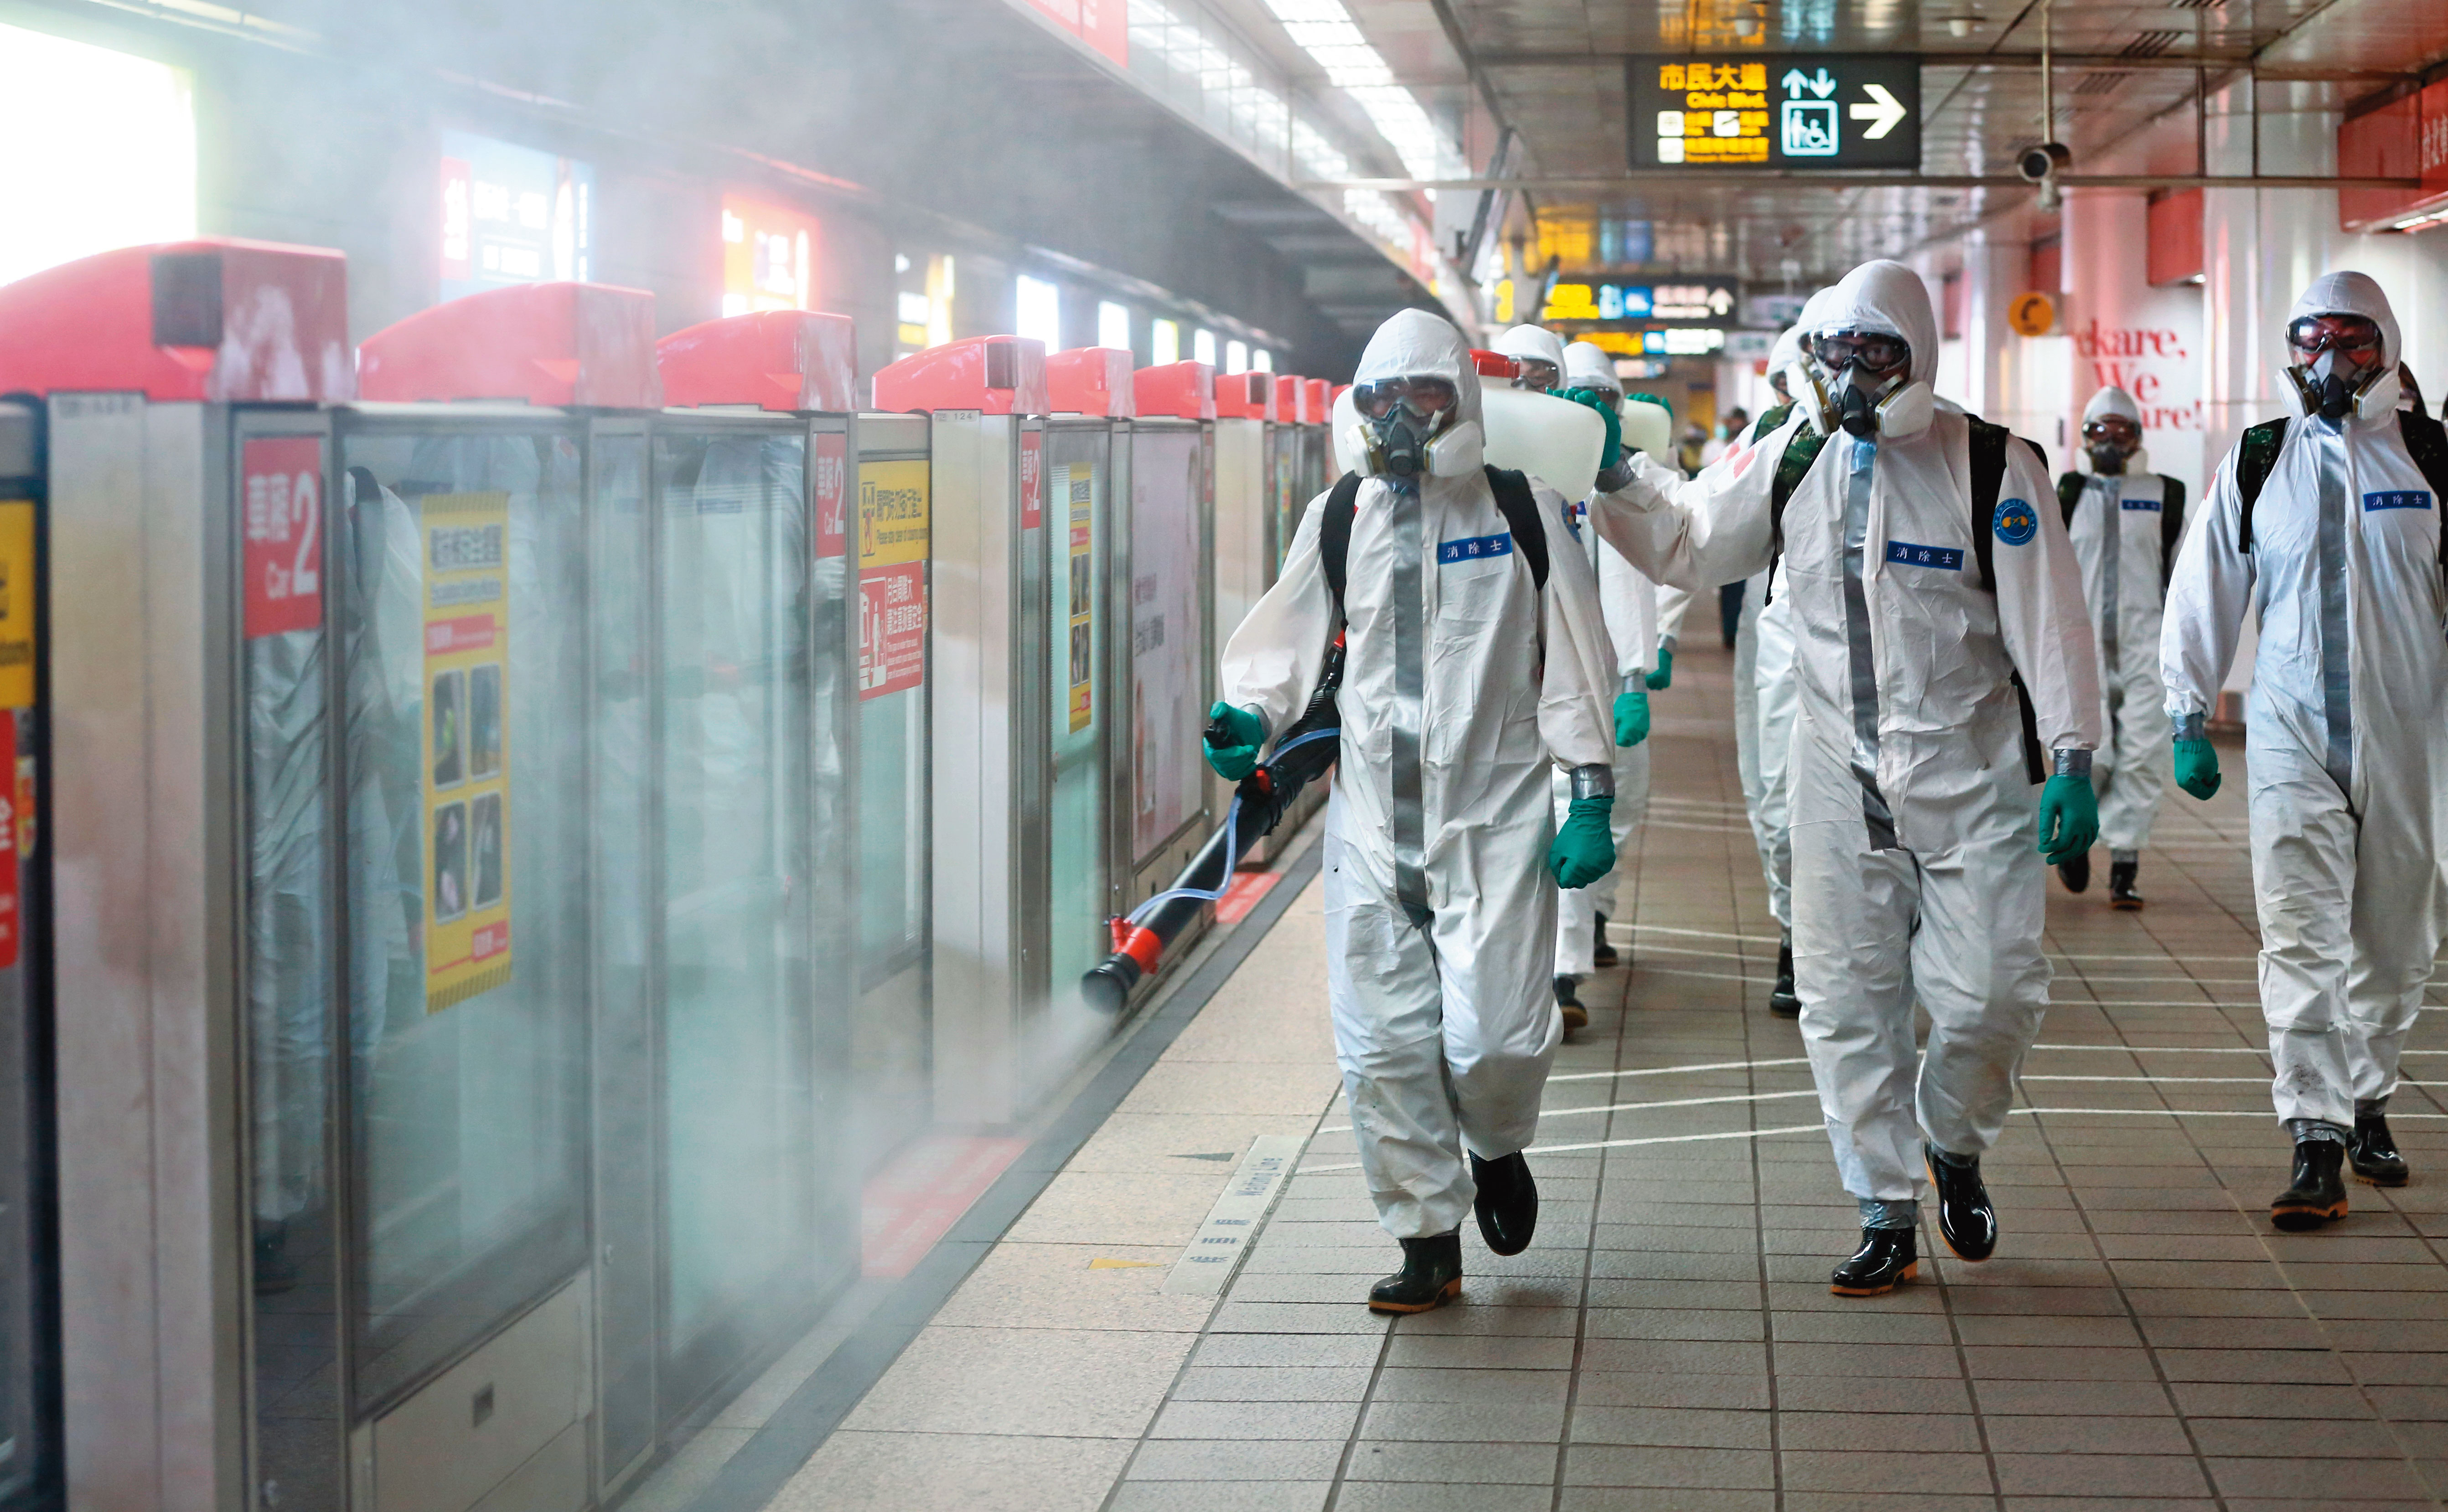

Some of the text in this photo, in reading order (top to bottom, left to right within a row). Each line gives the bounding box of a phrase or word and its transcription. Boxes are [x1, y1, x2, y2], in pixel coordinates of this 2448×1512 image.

[1660, 63, 1768, 90] 市民大道
[1033, 449, 1040, 510] 2
[834, 456, 844, 534] 2
[2373, 495, 2422, 506] 消除士
[293, 470, 318, 595] 2
[824, 511, 833, 535] Car
[1447, 540, 1501, 558] 消除士
[1896, 547, 1953, 563] 消除士
